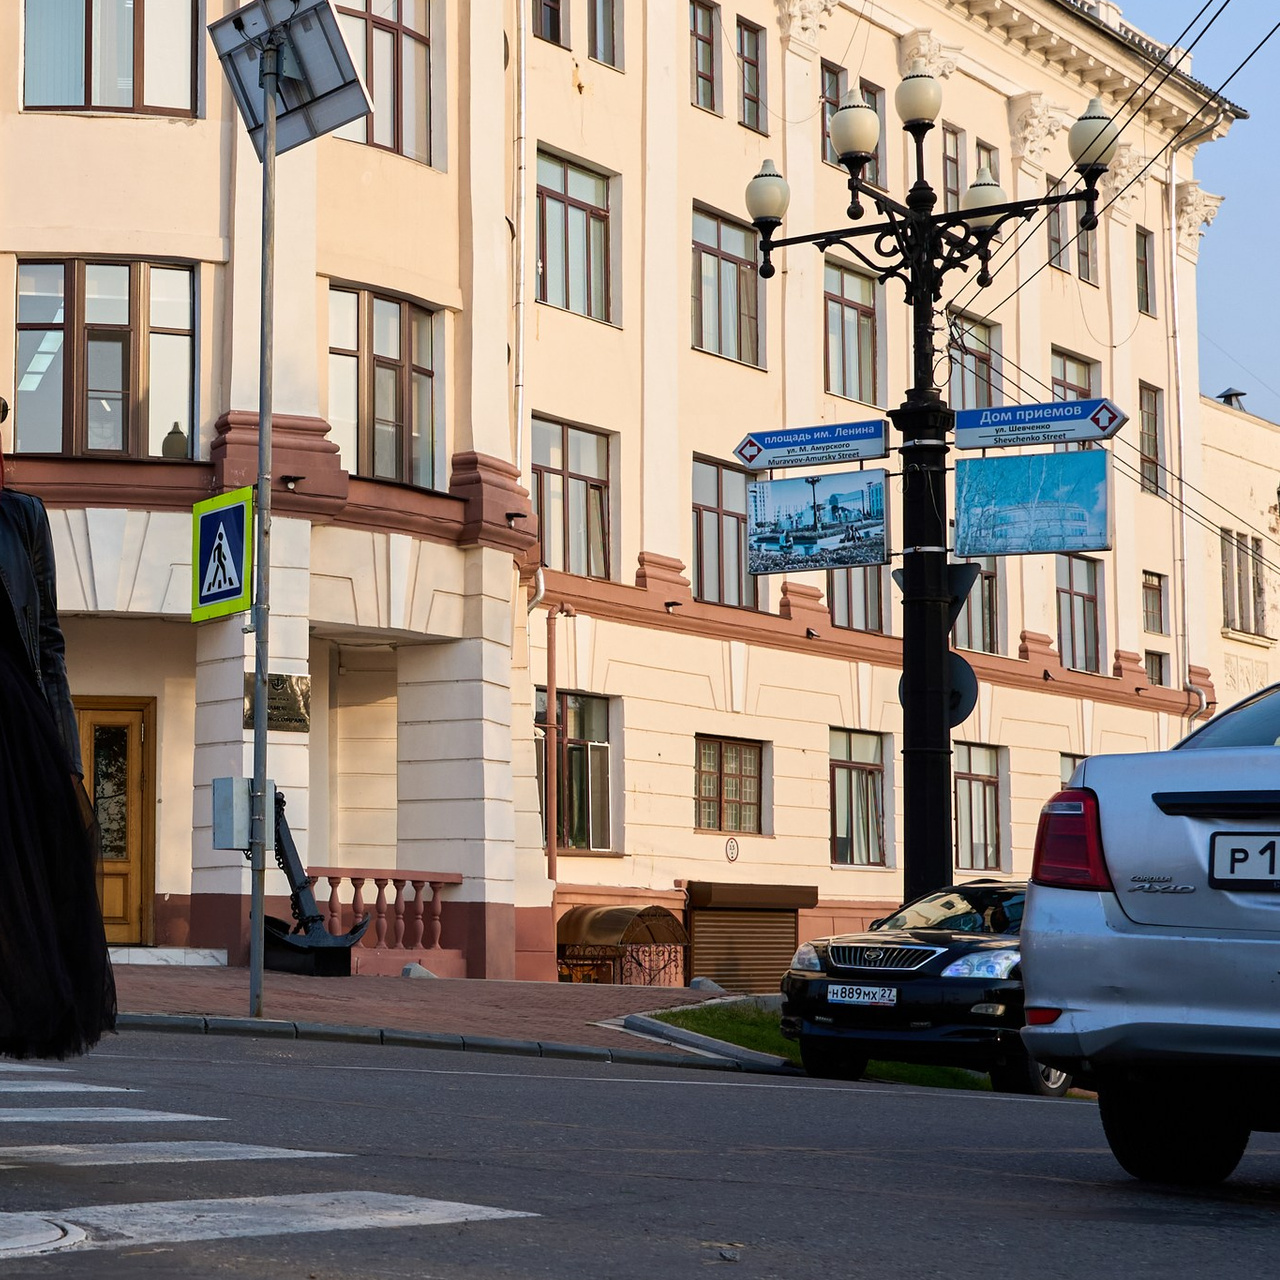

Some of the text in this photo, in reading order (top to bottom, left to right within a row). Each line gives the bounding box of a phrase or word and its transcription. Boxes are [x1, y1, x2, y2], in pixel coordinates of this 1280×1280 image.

[980, 406, 1082, 425] Дом приемов
[1008, 423, 1051, 432] Шевченко
[764, 426, 875, 444] площадь им. Ленина
[993, 433, 1066, 444] Shevchenko Street
[810, 442, 851, 452] Амурского
[837, 451, 860, 460] Street
[880, 988, 893, 999] 27
